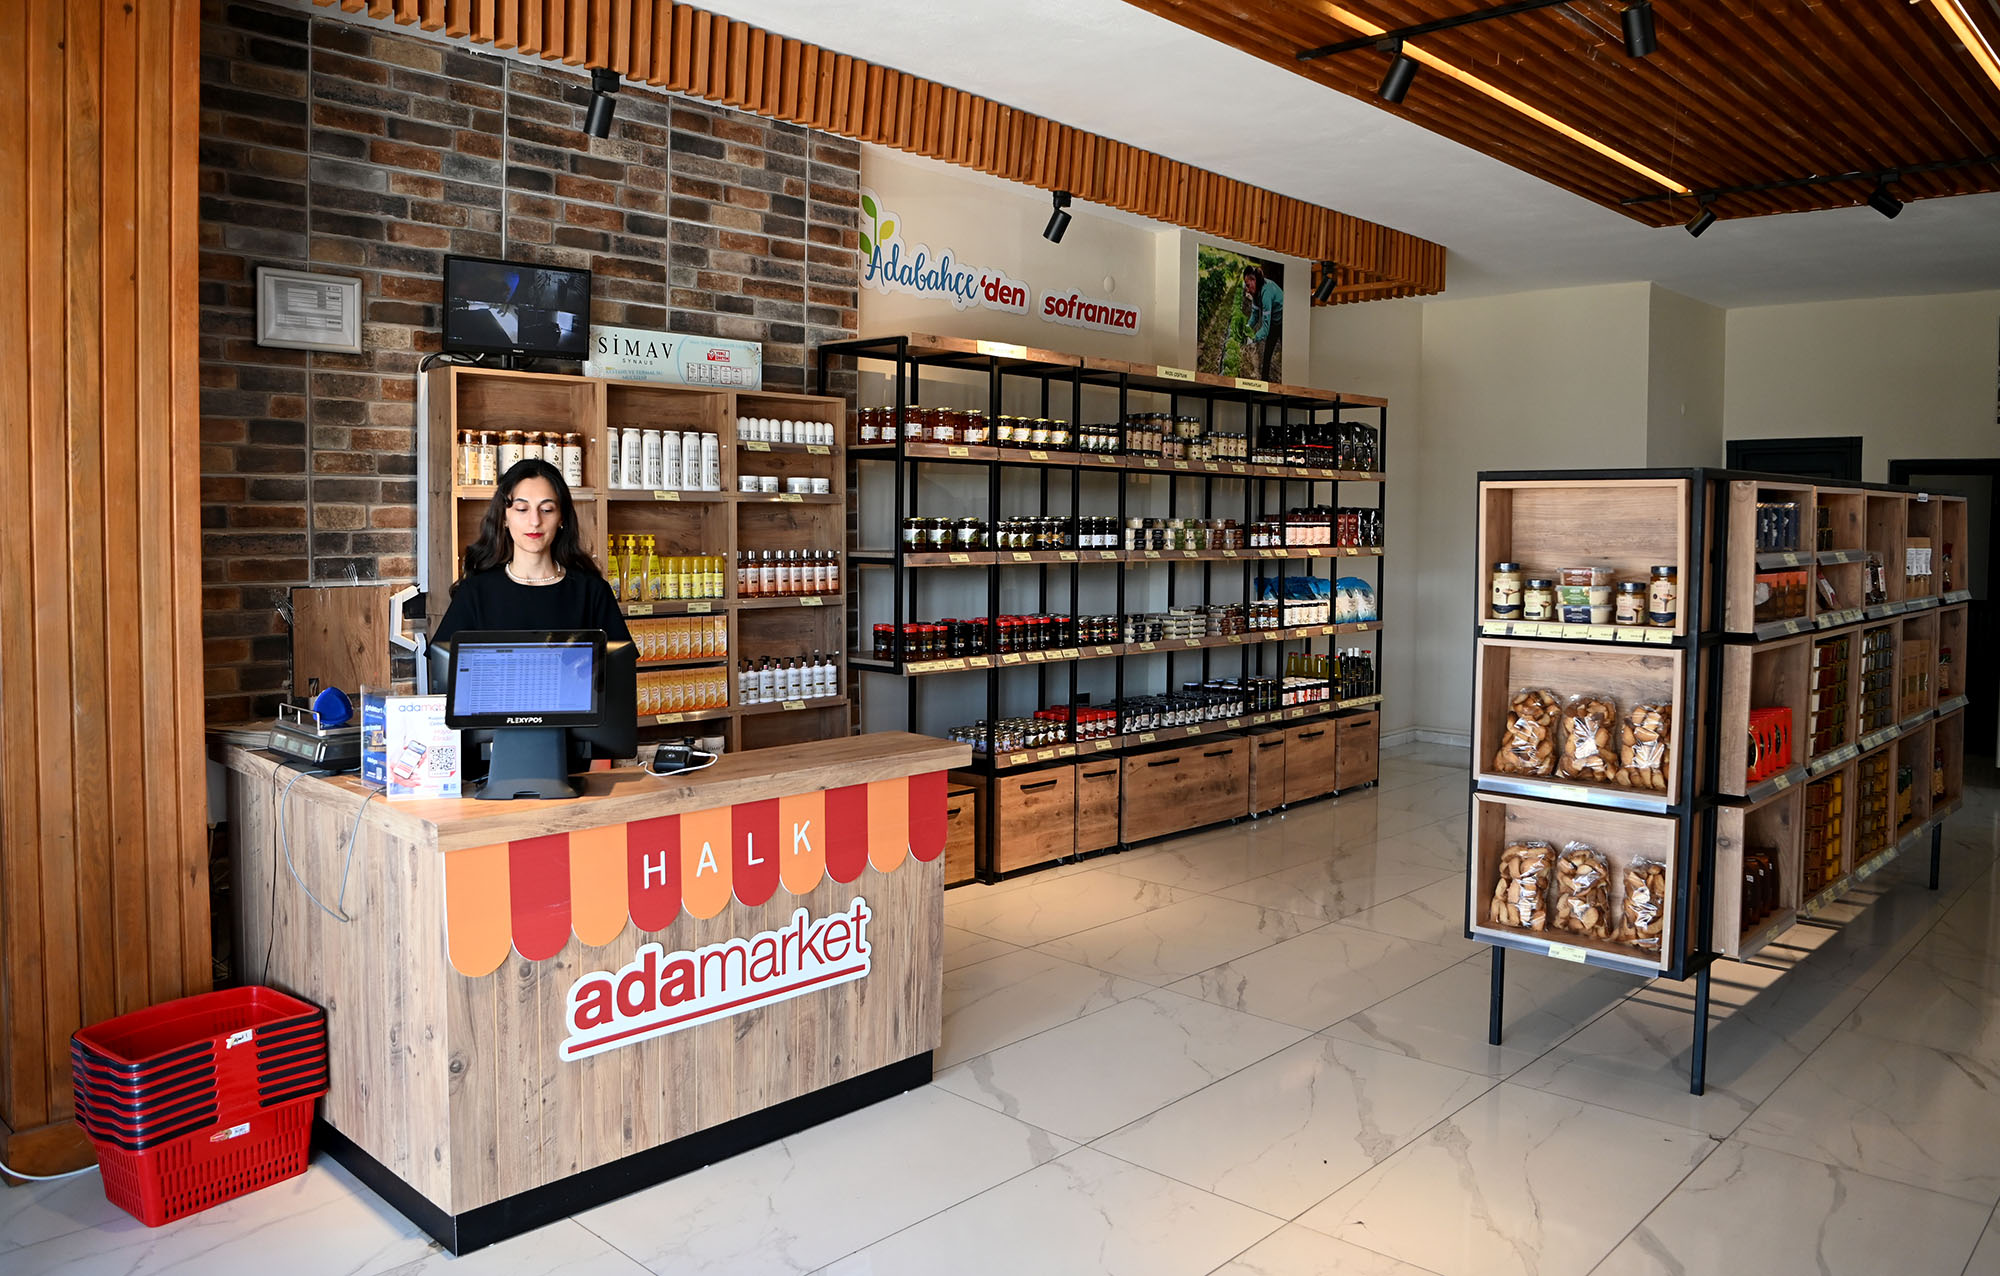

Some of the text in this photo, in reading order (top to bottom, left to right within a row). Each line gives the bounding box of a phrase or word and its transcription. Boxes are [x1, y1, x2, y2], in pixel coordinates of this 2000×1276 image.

[1044, 294, 1137, 329] sofranıza
[598, 333, 673, 359] SİMAV
[622, 358, 653, 366] SYNAUS
[643, 820, 812, 889] HALK
[573, 904, 867, 1030] adamarket
